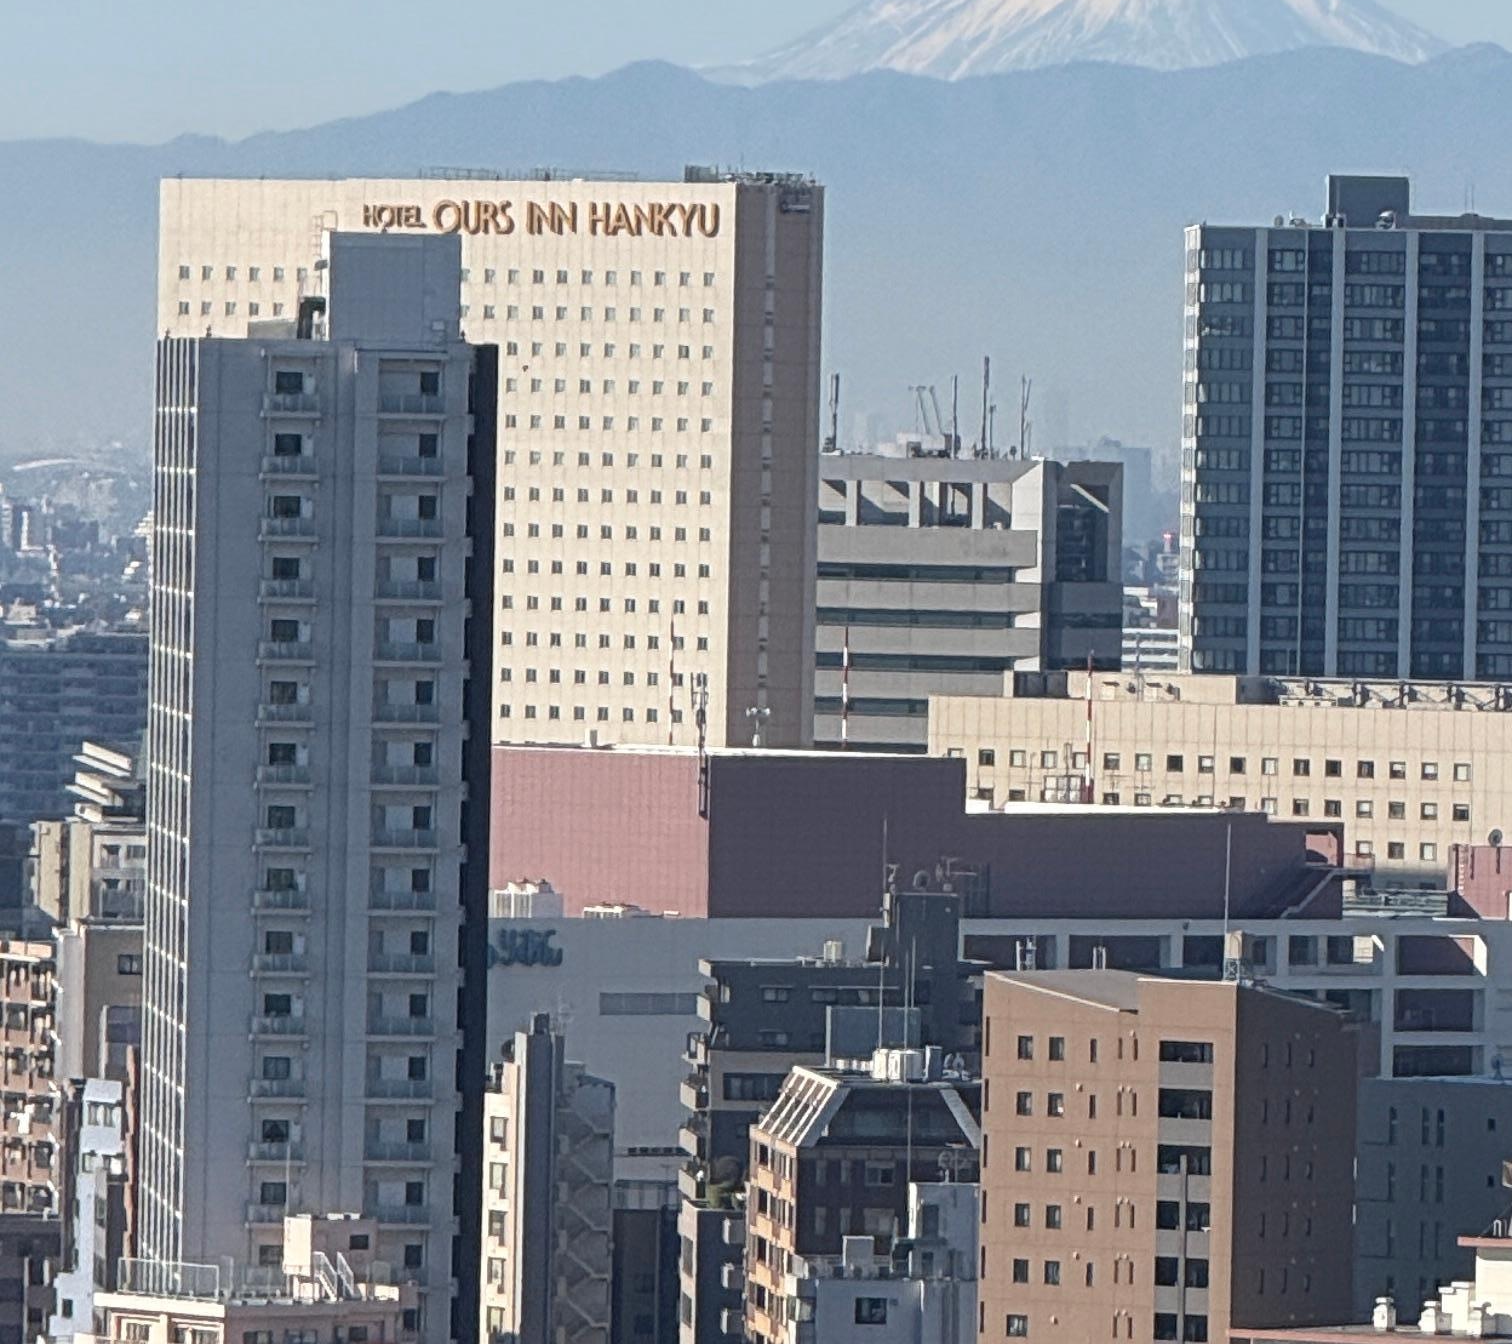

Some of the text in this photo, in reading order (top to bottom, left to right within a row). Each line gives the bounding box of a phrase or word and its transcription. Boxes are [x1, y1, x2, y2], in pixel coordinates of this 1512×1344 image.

[362, 199, 721, 238] HOTEL OURS INN HANKYU
